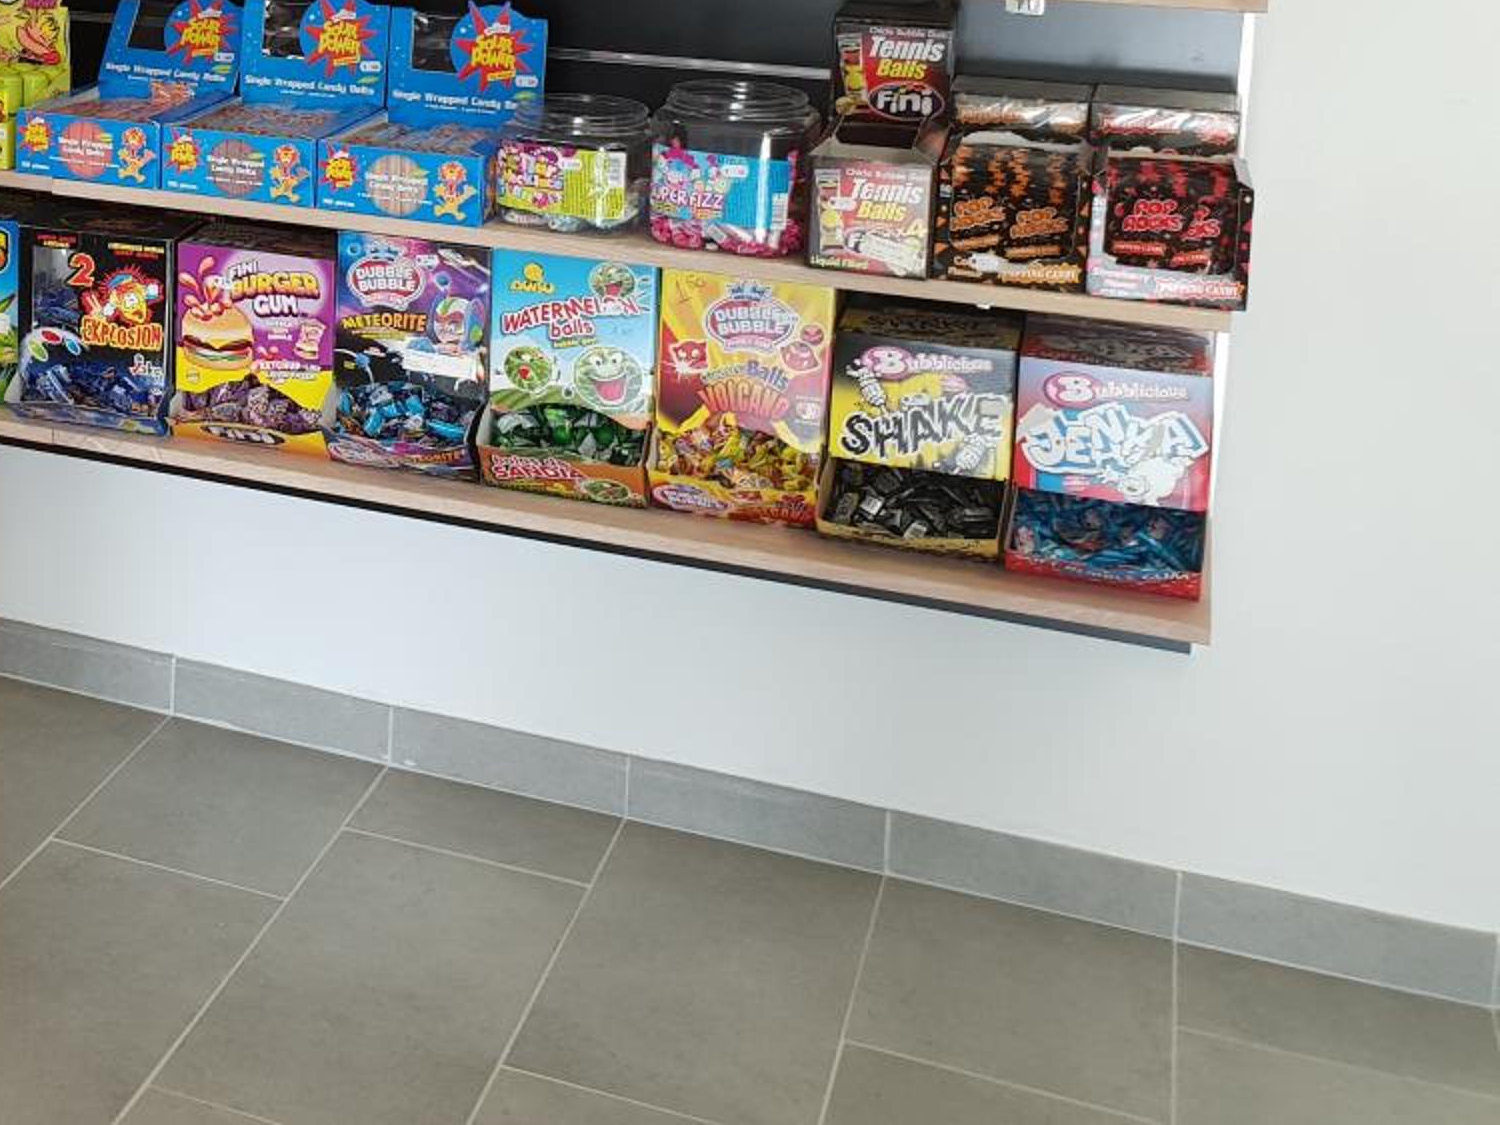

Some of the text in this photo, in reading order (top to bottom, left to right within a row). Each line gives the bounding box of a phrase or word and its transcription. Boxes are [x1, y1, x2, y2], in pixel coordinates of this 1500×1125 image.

[870, 35, 946, 62] Tennis
[876, 59, 928, 80] Balls
[275, 78, 314, 91] Wrapped
[876, 87, 934, 117] Fini
[690, 187, 725, 208] FIZZ
[851, 179, 924, 204] Tennis
[857, 201, 907, 222] Balls
[67, 253, 95, 286] 2
[356, 266, 414, 280] DUBBLE
[231, 272, 321, 300] BURGER
[358, 278, 416, 292] BUBBLE
[253, 293, 299, 317] GUM
[714, 306, 786, 321] DUBBLE
[81, 315, 164, 350] EXPLOSION
[341, 312, 427, 332] METEORITE
[551, 319, 594, 337] balls
[717, 320, 786, 335] BUBBLE
[697, 378, 790, 419] VOLCANO
[1056, 375, 1189, 403] Bubblicious
[841, 391, 1012, 458] SHAKE
